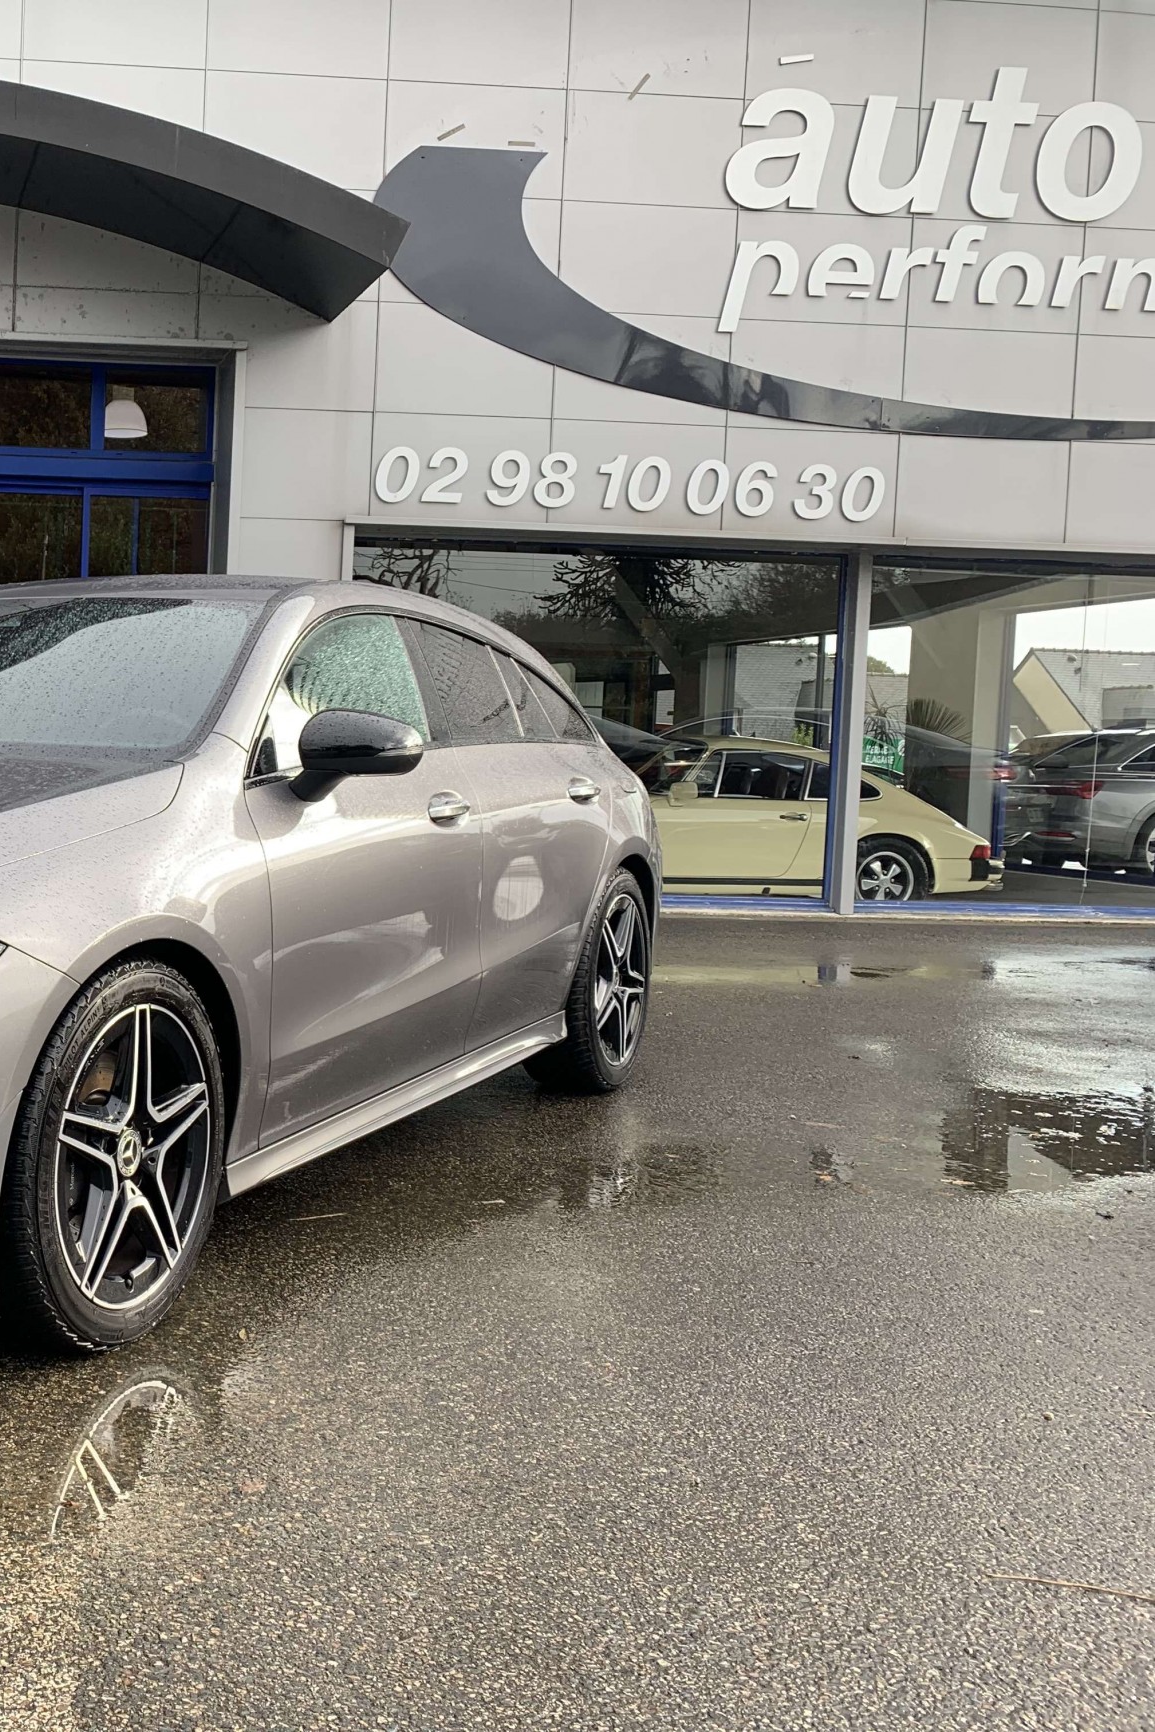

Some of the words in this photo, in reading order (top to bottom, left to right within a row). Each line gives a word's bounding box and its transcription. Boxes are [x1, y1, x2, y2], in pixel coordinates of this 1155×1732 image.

[725, 66, 1144, 222] auto
[374, 446, 469, 504] 02
[486, 449, 578, 508] 98
[598, 454, 672, 512] 10
[686, 459, 778, 518] 06
[793, 464, 886, 522] 30
